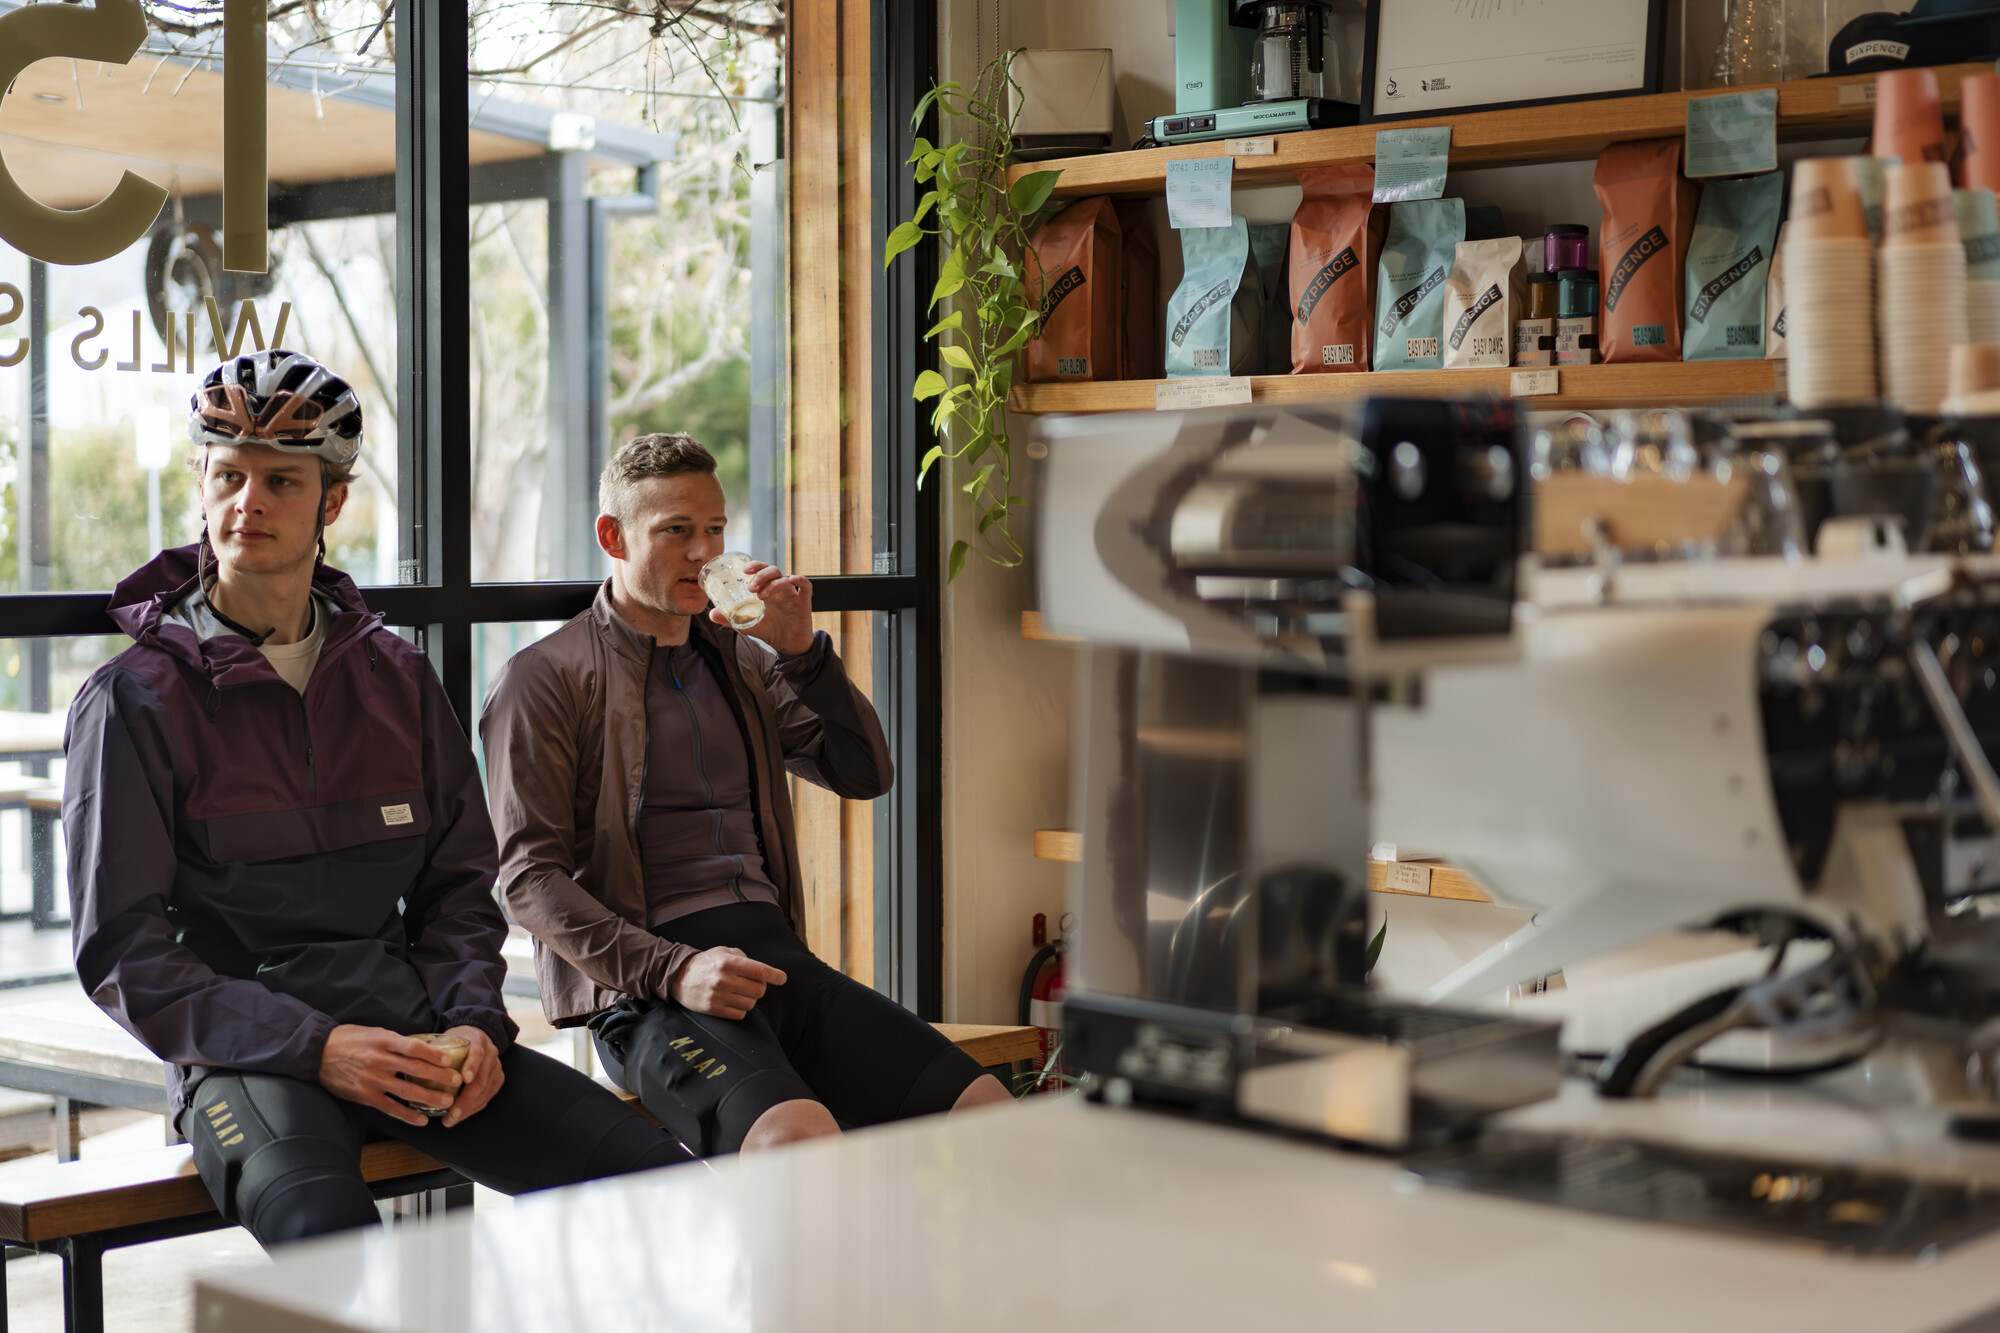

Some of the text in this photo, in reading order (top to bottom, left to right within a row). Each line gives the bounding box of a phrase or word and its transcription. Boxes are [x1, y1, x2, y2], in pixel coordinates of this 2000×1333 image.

[1849, 43, 1904, 59] SIXPENCE
[1253, 111, 1297, 120] MOCCAMASTER
[1409, 133, 1433, 142] Days
[1194, 161, 1219, 171] Blend
[1606, 231, 1663, 307] SIXPENCE
[1300, 252, 1354, 321] SIXPENCE
[1694, 251, 1759, 317] SIXPENCE
[1384, 270, 1442, 332] SIXPENCE
[1174, 283, 1228, 342] SIXPENCE
[1452, 288, 1499, 347] SIXPENCE
[1473, 336, 1503, 355] EASY DAYS
[1633, 325, 1666, 346] SEASONAL
[1727, 324, 1760, 346] SEASONAL
[1204, 349, 1220, 366] BLEND
[1323, 345, 1353, 364] EASY DAYS
[1407, 338, 1437, 357] EASY DAYS
[1070, 357, 1087, 374] BLEND
[668, 1036, 728, 1080] MAAP
[205, 1100, 245, 1148] MAAP
